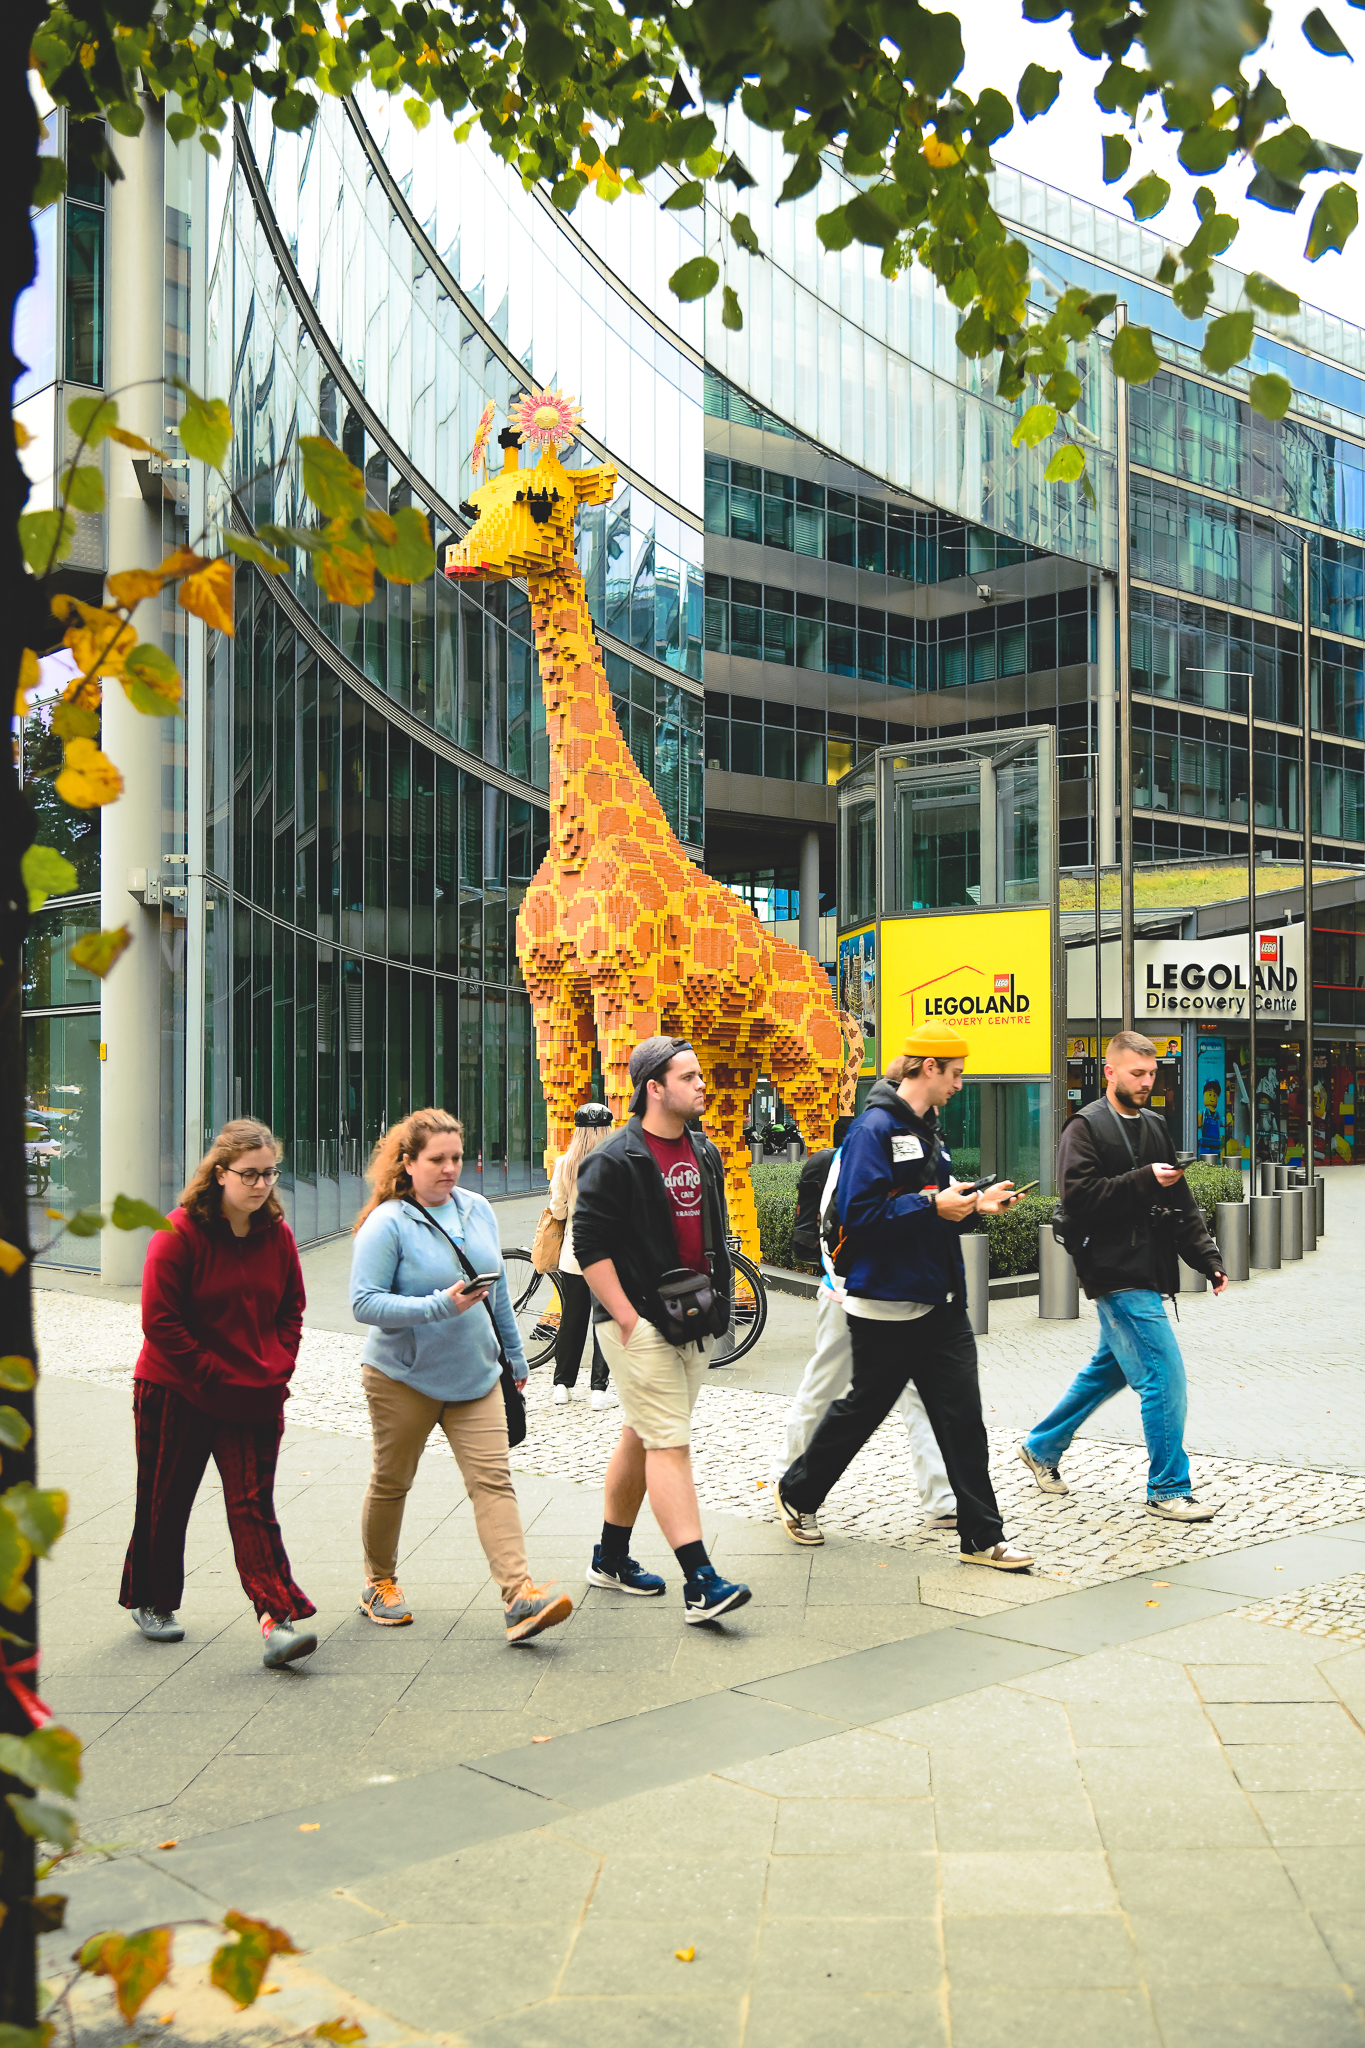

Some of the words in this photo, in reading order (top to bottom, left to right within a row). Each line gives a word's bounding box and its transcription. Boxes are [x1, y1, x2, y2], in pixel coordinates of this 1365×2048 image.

[1260, 942, 1277, 954] LEGO
[1146, 935, 1298, 992] LEGOLAND
[994, 979, 1009, 988] LEGO
[925, 974, 1030, 1016] LEGOLAND
[1146, 992, 1245, 1014] Discovery
[1254, 994, 1297, 1011] Centre
[988, 1015, 1031, 1025] CENTRE
[661, 1171, 685, 1188] ard
